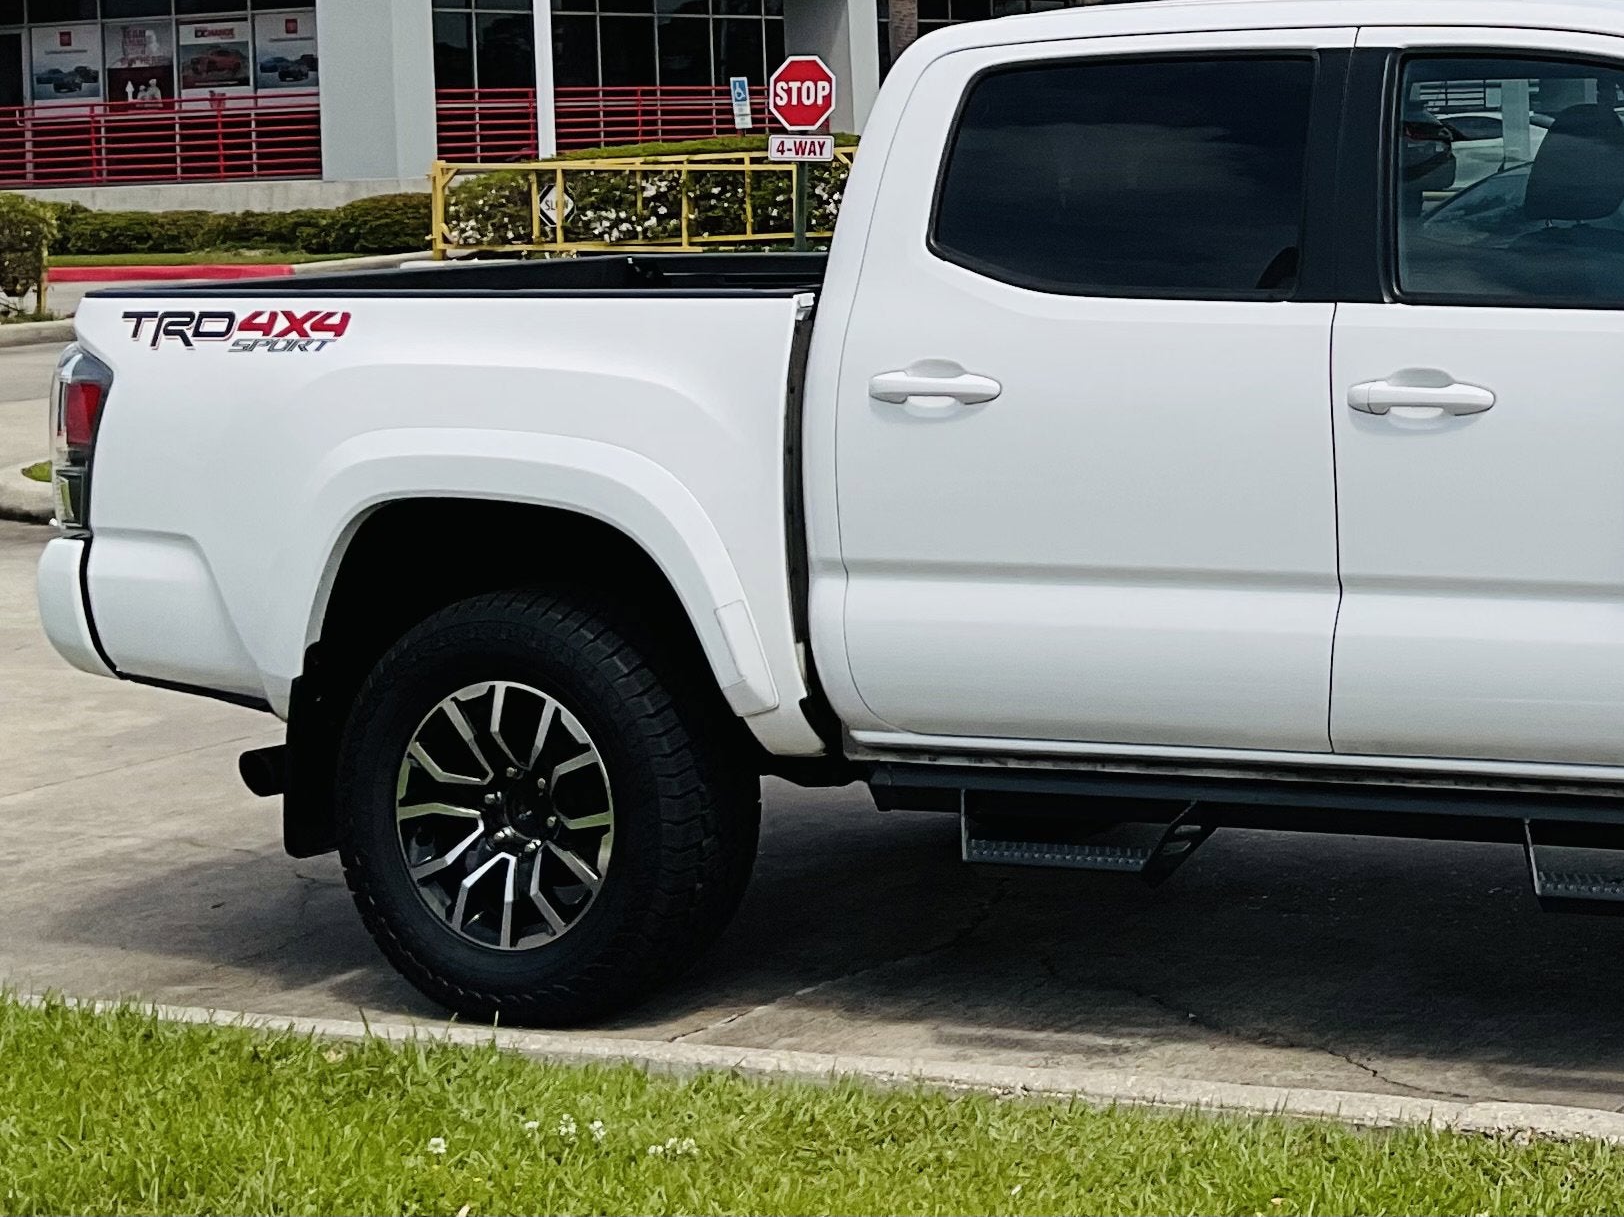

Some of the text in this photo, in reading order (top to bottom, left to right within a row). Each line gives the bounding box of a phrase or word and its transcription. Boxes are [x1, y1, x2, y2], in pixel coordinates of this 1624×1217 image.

[775, 80, 831, 106] STOP
[776, 140, 826, 157] 4-WAY
[545, 199, 569, 210] SLW
[121, 311, 236, 348] TRD
[228, 339, 338, 353] SPORT
